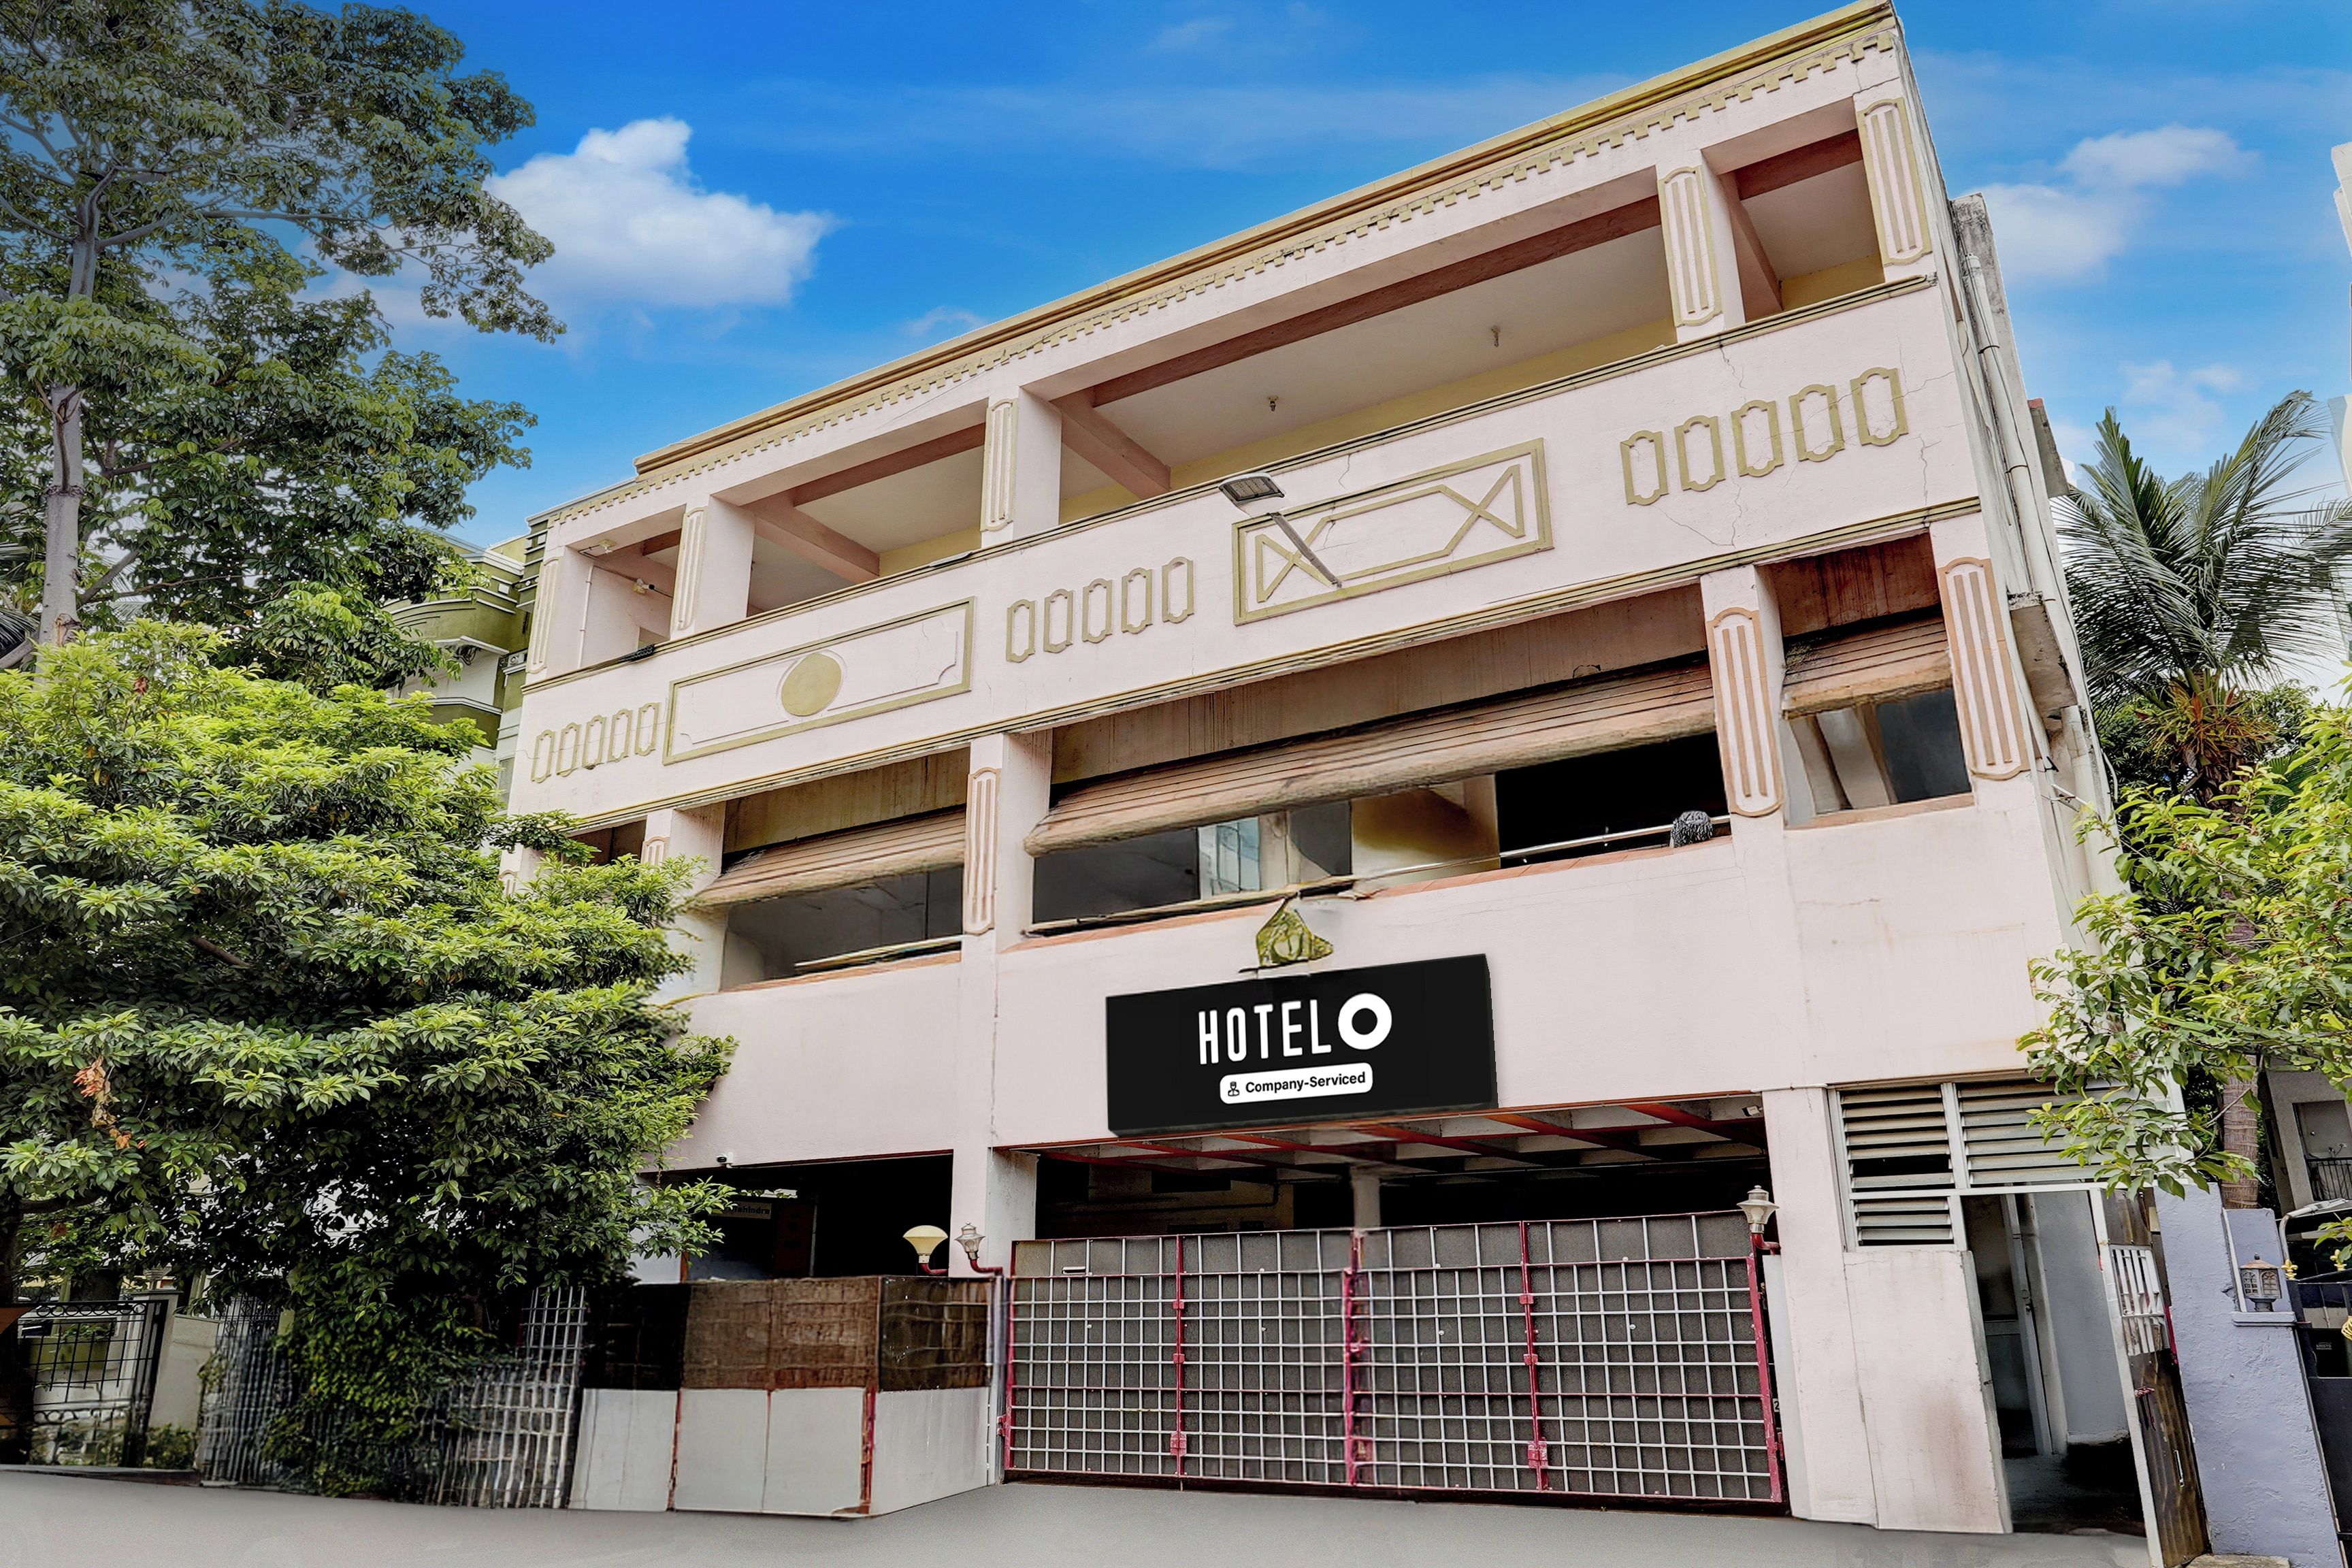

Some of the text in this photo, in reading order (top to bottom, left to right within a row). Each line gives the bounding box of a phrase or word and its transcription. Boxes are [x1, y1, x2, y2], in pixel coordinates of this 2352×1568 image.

[1198, 993, 1392, 1065] HOTEL O
[1245, 1071, 1366, 1094] Company-Serviced
